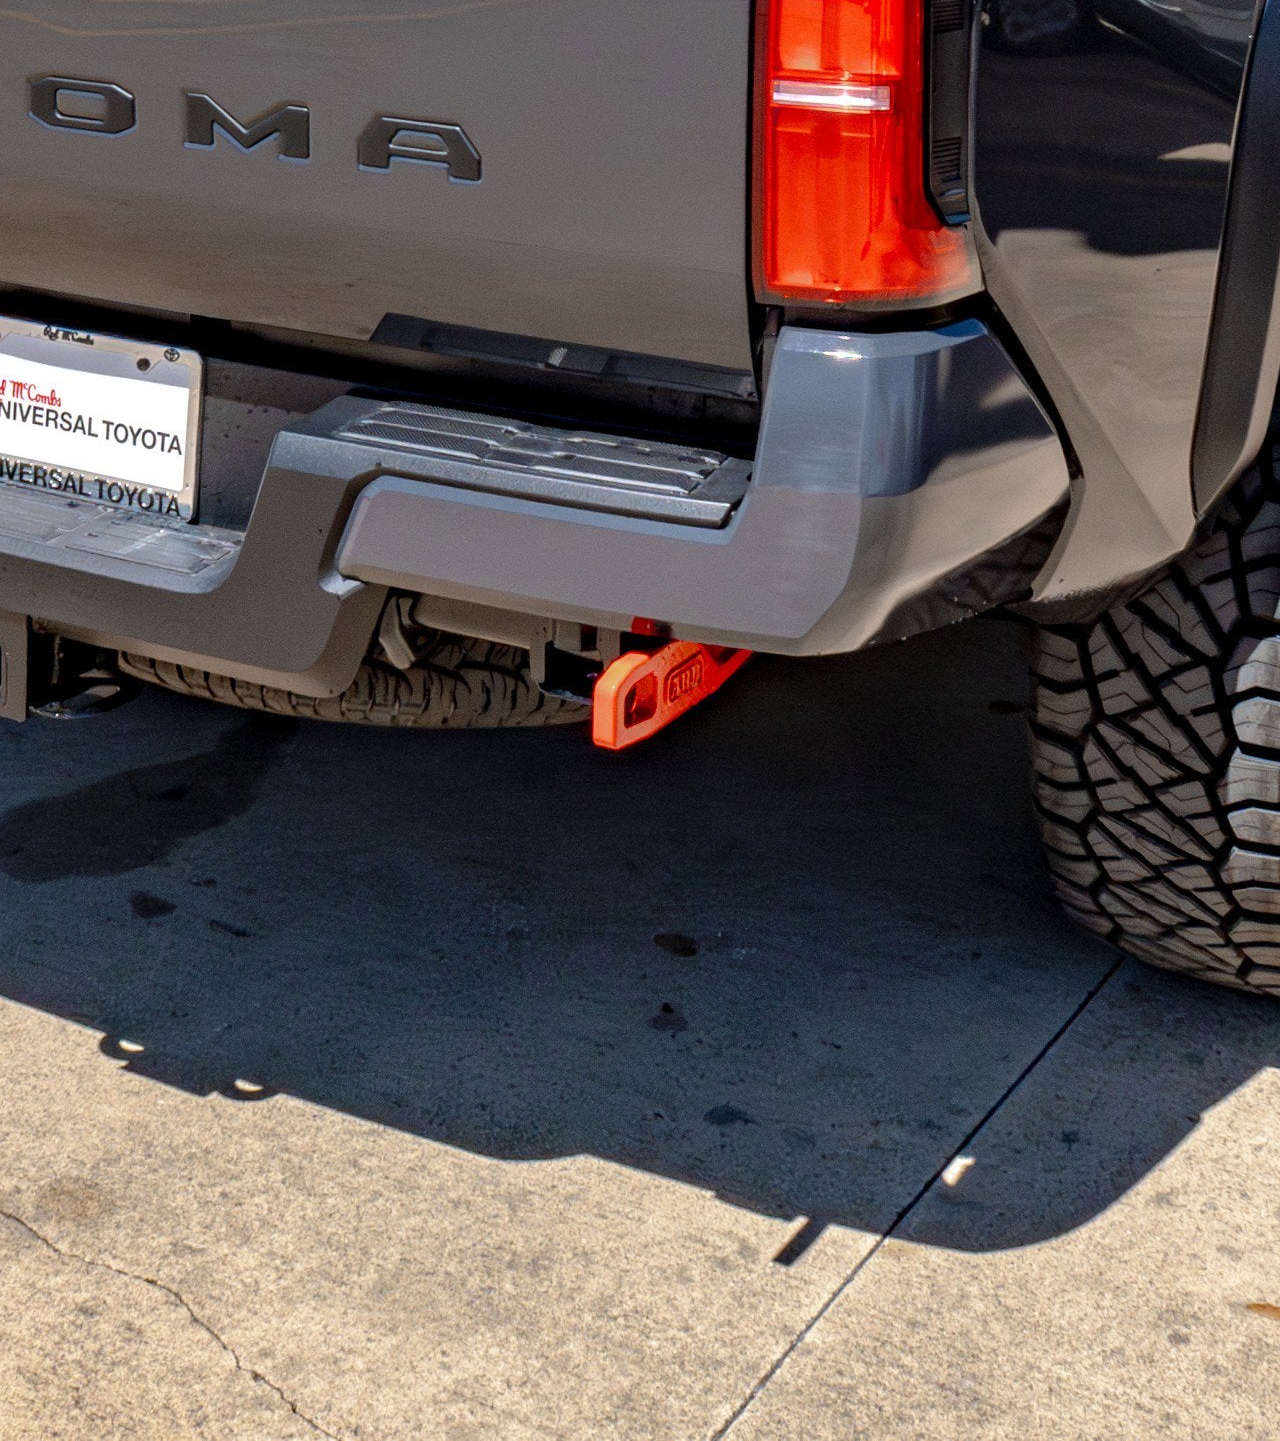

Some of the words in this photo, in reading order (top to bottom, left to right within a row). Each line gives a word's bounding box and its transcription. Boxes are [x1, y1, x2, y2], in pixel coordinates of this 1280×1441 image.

[9, 380, 62, 407] McCombs
[102, 420, 182, 455] TOYOTA
[94, 478, 182, 517] TOYOTA
